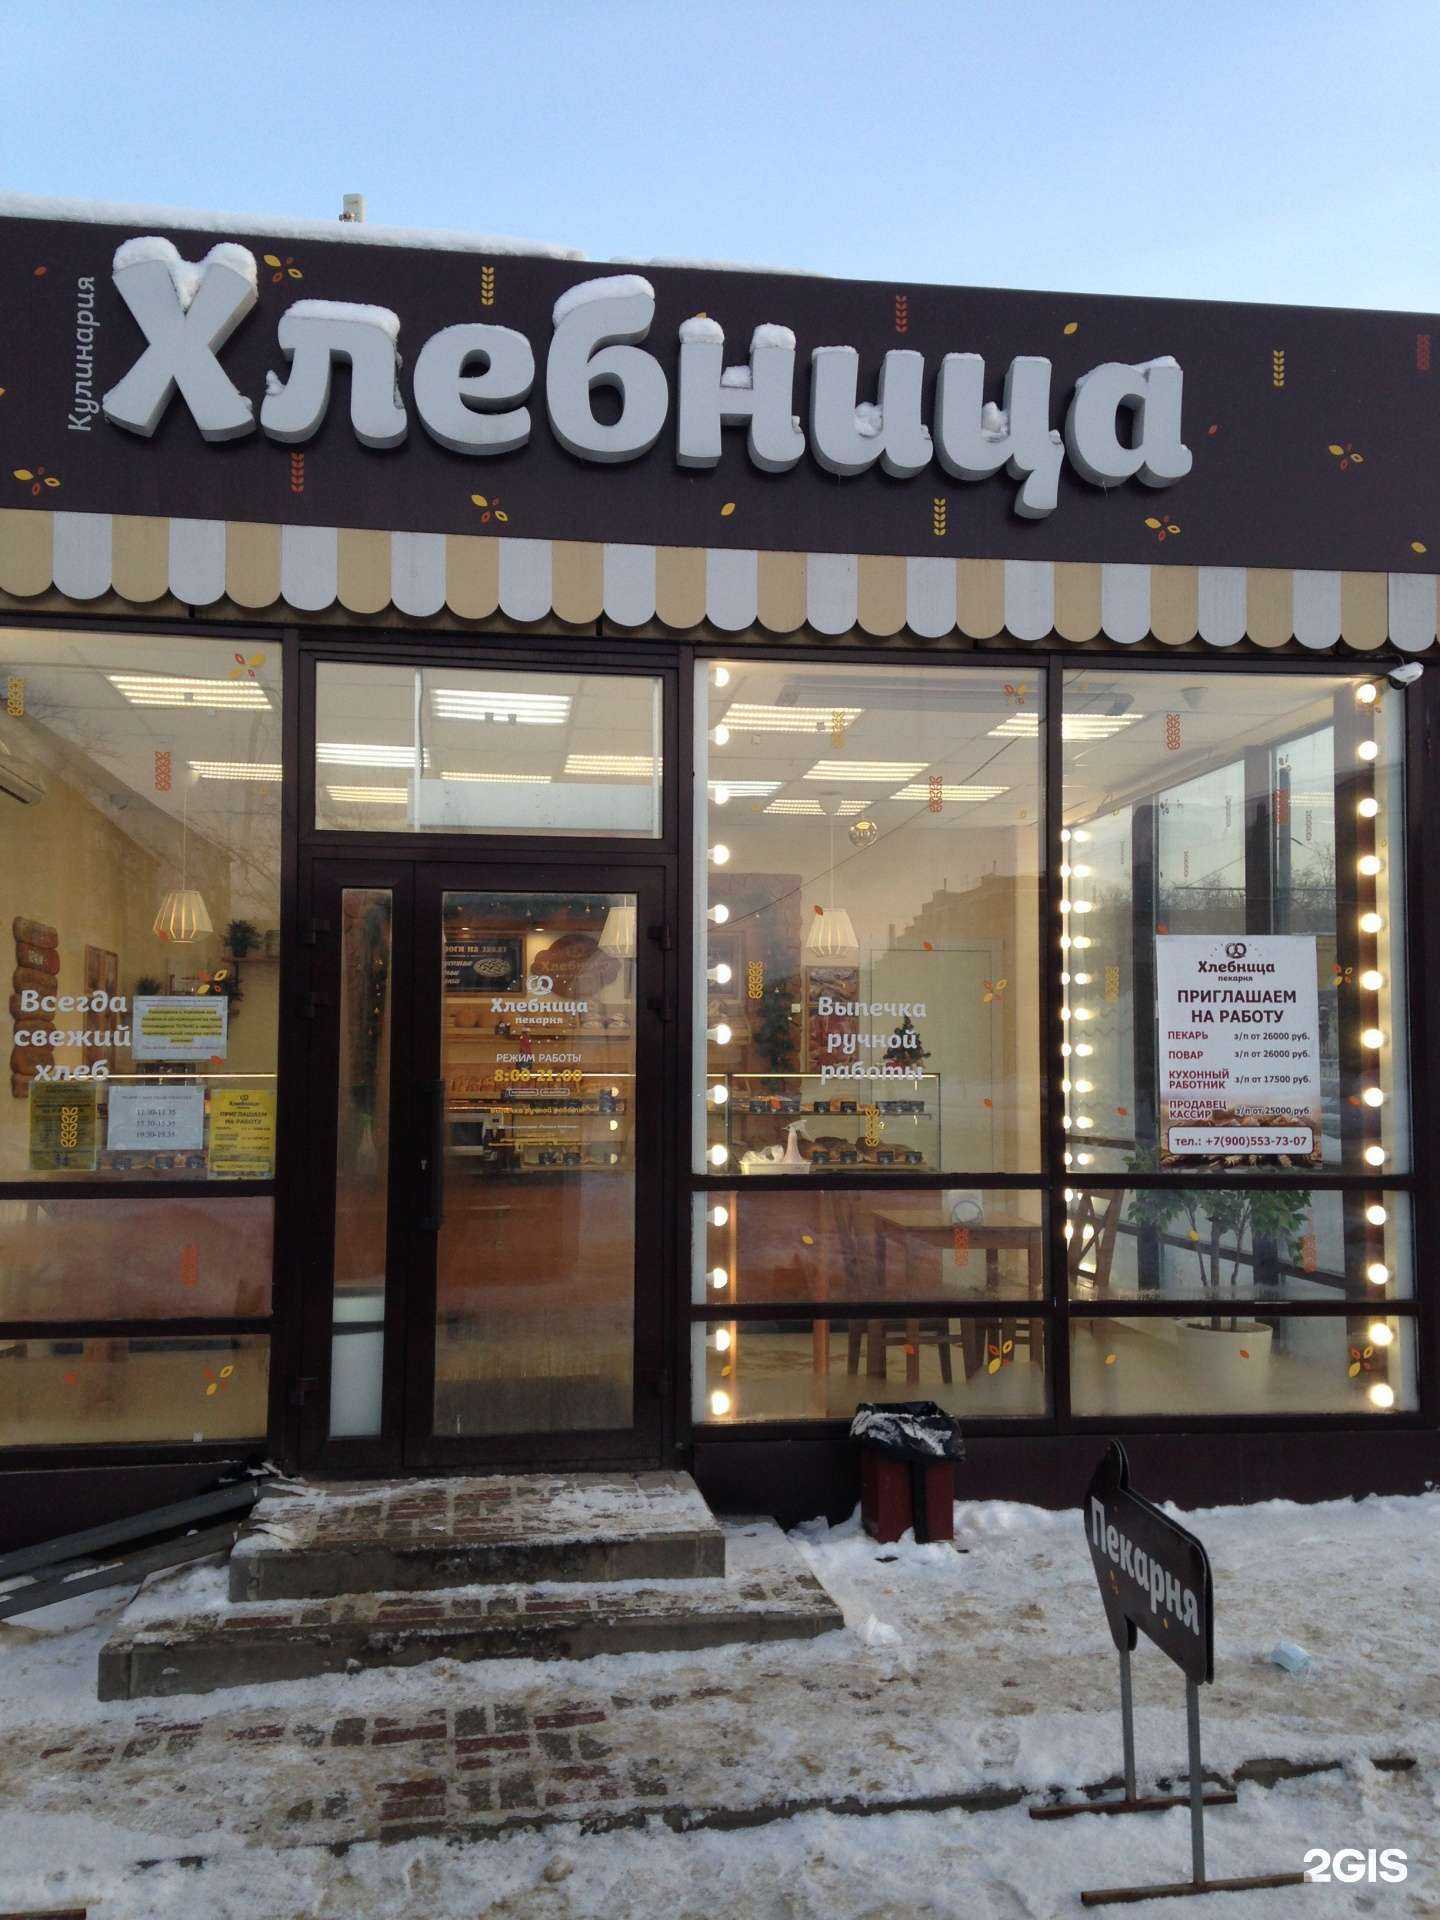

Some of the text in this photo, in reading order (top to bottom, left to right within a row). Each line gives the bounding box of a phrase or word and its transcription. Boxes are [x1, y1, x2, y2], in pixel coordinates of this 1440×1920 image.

[67, 276, 101, 432] Кулинария
[102, 237, 1193, 520] Хлебница
[1198, 960, 1275, 974] Хлебница
[1218, 975, 1253, 983] пекарня
[20, 990, 128, 1013] Всегда
[1177, 990, 1297, 1003] ПРИГЛАШАЕМ
[490, 998, 589, 1015] Хлебница
[817, 996, 927, 1018] Выпечка
[515, 1015, 564, 1025] пекарня
[1191, 1010, 1284, 1023] НА РАБОТУ
[14, 1024, 131, 1047] свежий
[827, 1029, 918, 1054] ручной
[1168, 1031, 1208, 1040] ПЕКАРЬ
[1234, 1032, 1249, 1041] з/п
[1263, 1032, 1290, 1040] 26000
[1292, 1033, 1310, 1042] руб.
[496, 1053, 582, 1063] РЕЖИМ РАБОТЫ
[1168, 1051, 1204, 1060] ПОВАР
[1234, 1050, 1250, 1059] з/п
[1263, 1050, 1290, 1058] 26000
[1292, 1050, 1310, 1060] руб.
[34, 1059, 110, 1082] хлеб
[493, 1068, 583, 1083] 8:00-21:00
[820, 1061, 923, 1085] работы
[1168, 1068, 1230, 1079] КУХОННЫЙ
[1169, 1080, 1226, 1089] РАБОТНИК
[1235, 1075, 1250, 1084] з/п
[1264, 1075, 1291, 1083] 17500
[1293, 1076, 1311, 1085] руб.
[1169, 1100, 1227, 1111] ПРОДАВЕЦ
[1236, 1107, 1251, 1116] з/п
[1264, 1106, 1292, 1115] 25000
[1169, 1110, 1212, 1119] КАССИР
[1175, 1135, 1308, 1148] тел.: +7(900)553-73-07
[1090, 1496, 1200, 1636] Пекарня
